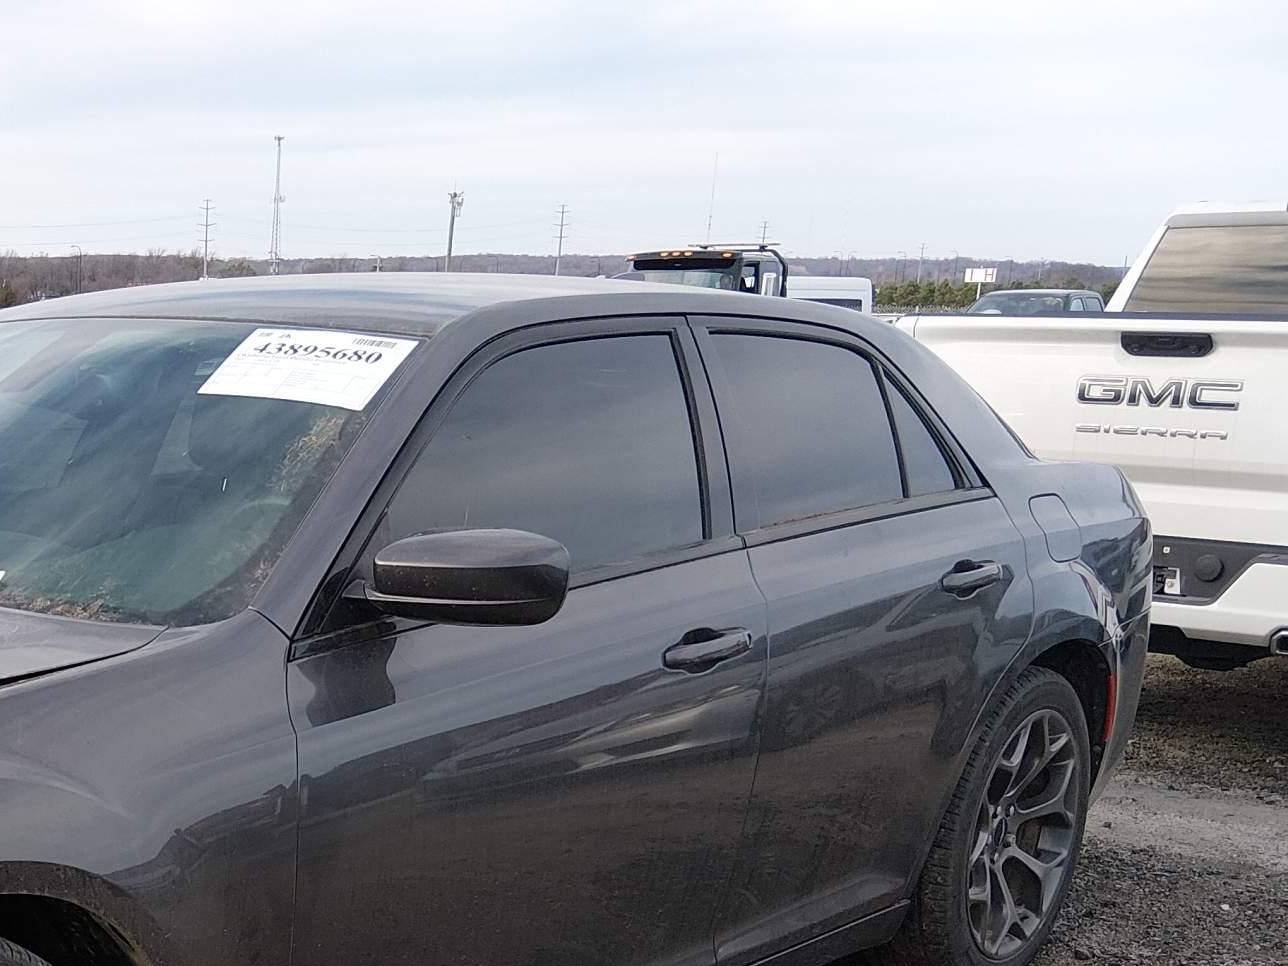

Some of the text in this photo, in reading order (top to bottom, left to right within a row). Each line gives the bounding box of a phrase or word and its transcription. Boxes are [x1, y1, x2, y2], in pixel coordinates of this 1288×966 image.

[253, 342, 383, 364] 43895680
[1076, 375, 1245, 411] GMC
[1075, 423, 1228, 440] SIERRA
